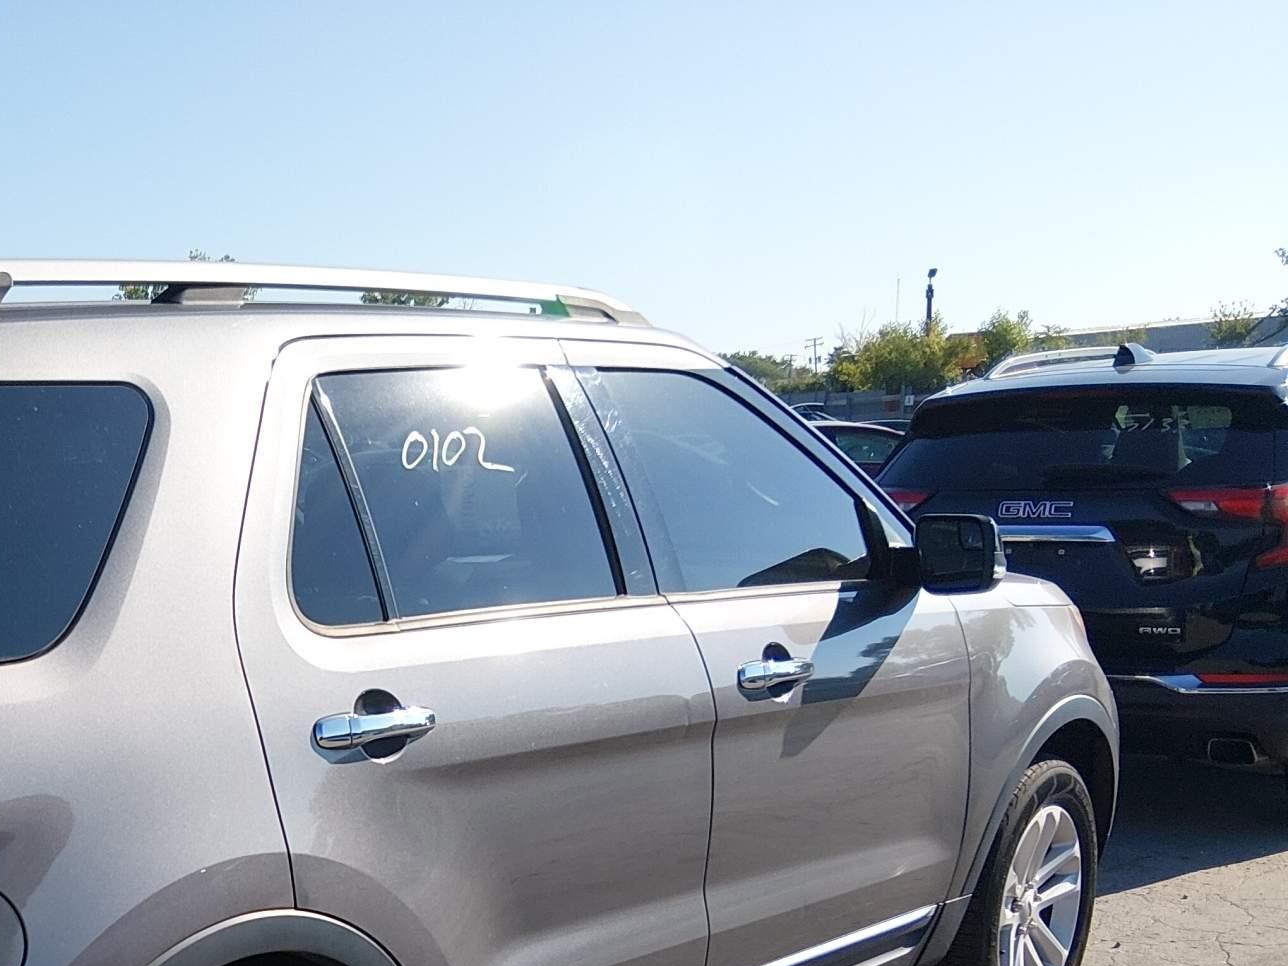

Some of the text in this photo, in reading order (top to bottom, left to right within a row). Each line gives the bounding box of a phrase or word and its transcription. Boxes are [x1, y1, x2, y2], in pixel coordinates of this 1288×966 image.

[401, 426, 515, 472] 0102
[998, 500, 1073, 518] GMC
[1138, 626, 1182, 635] AWD
